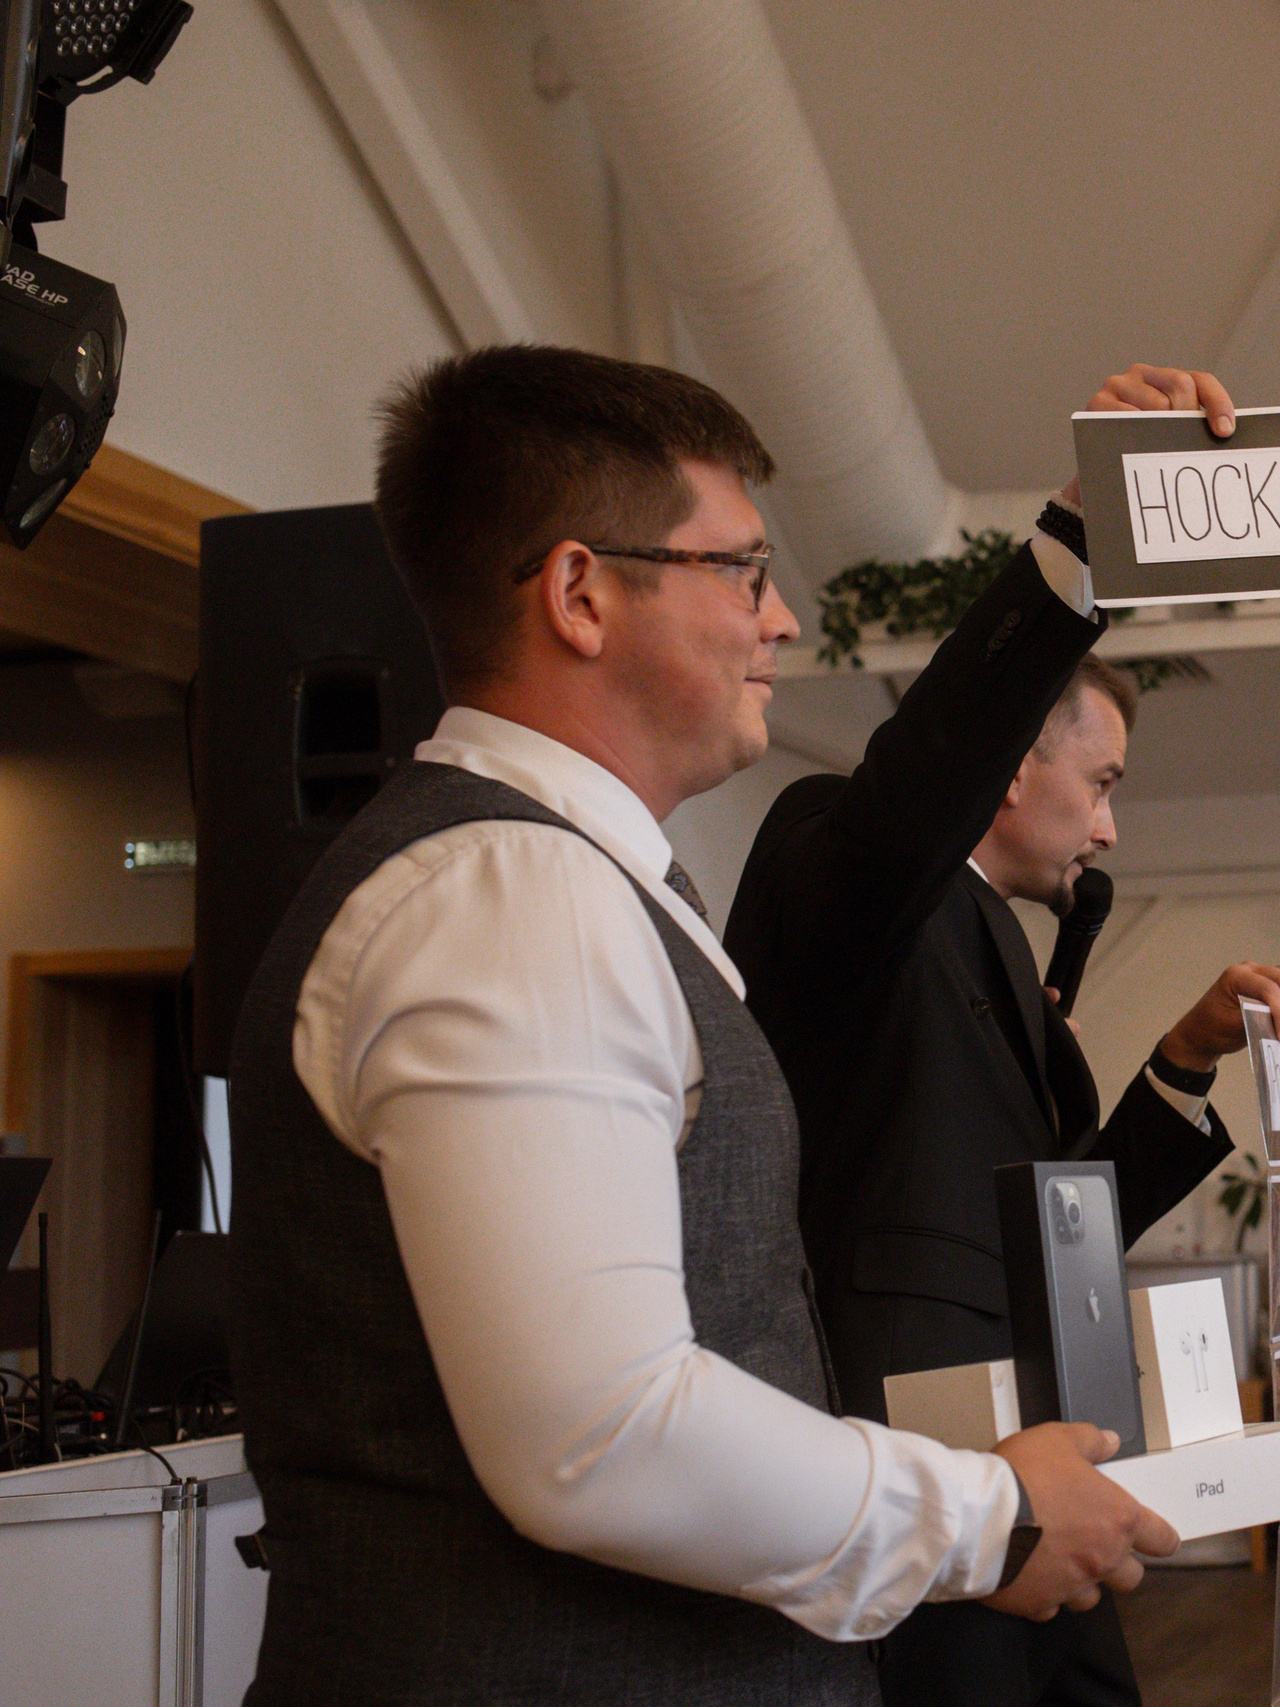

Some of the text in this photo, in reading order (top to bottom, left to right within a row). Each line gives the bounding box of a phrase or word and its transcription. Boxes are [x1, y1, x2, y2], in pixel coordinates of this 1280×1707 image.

[6, 264, 35, 282] AD
[41, 290, 69, 304] HP
[1195, 1479, 1225, 1498] iPad
